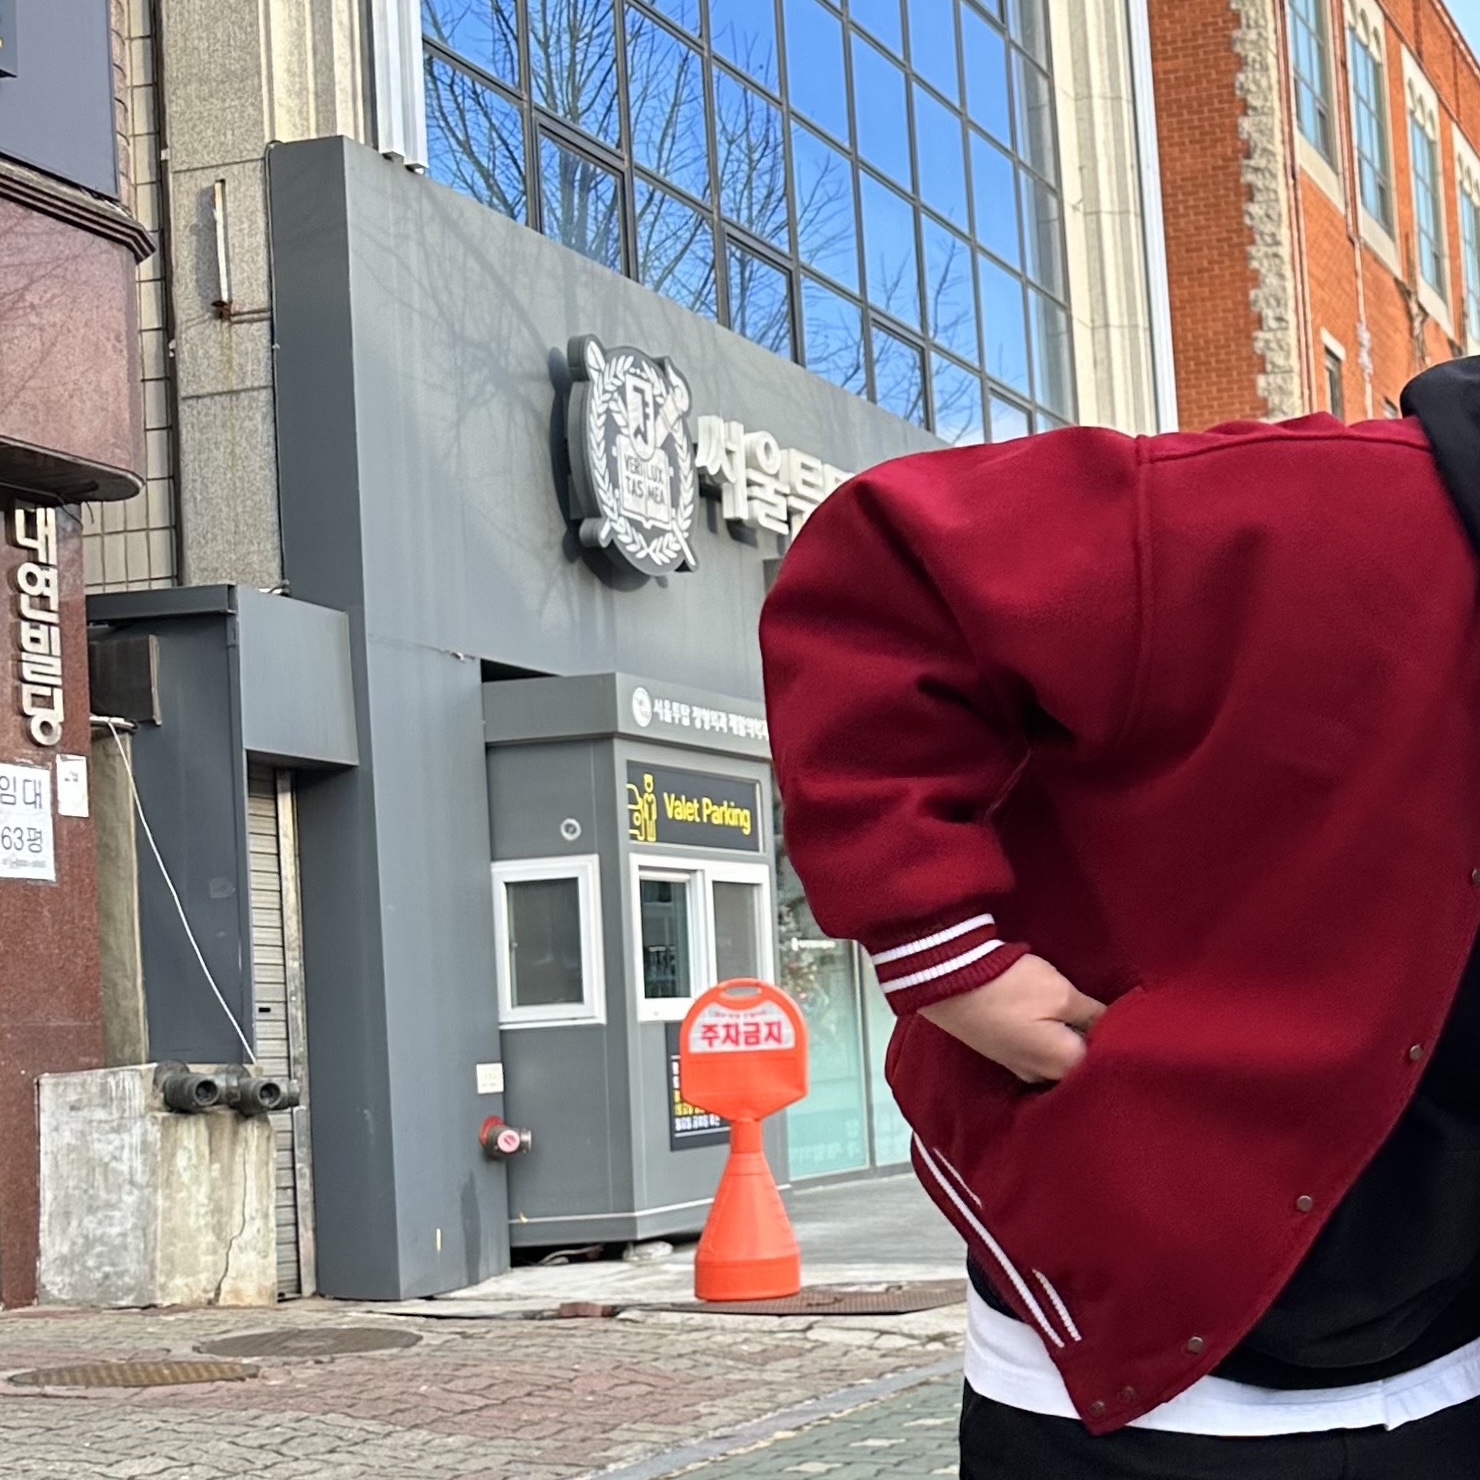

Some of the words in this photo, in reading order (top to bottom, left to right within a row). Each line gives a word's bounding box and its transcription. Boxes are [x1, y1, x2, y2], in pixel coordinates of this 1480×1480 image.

[625, 475, 644, 498] TAS
[647, 484, 666, 505] MEA
[0, 775, 43, 810] 임대
[663, 791, 701, 824] Valet
[702, 796, 752, 836] Parking
[701, 1020, 783, 1048] 주차금지
